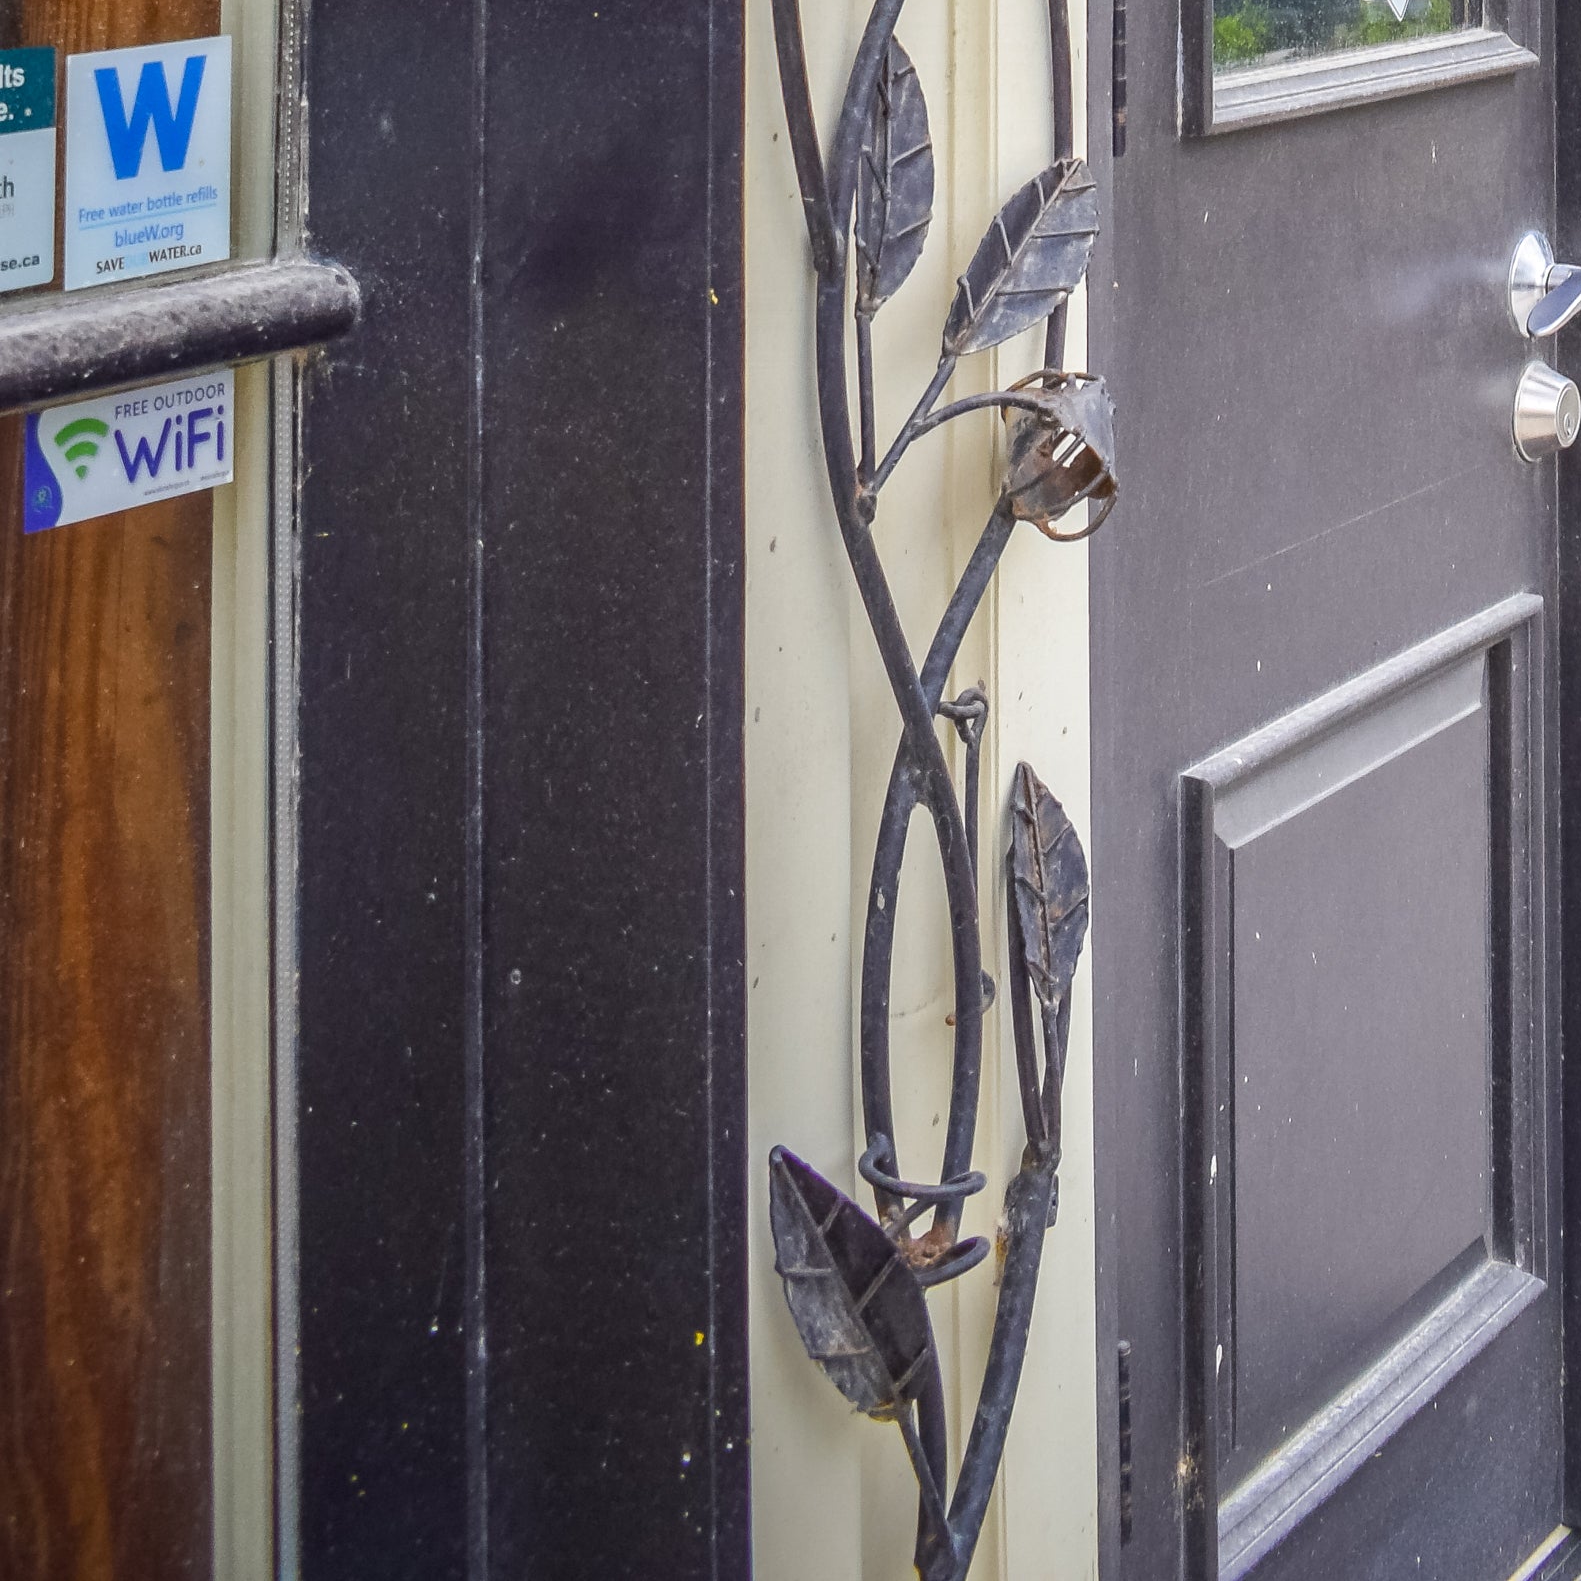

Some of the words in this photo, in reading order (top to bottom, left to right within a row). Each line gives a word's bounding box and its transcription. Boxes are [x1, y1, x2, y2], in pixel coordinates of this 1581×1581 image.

[94, 55, 207, 181] W
[79, 207, 105, 224] Free
[109, 202, 142, 217] water
[147, 192, 182, 211] bottle
[186, 186, 218, 204] refills
[114, 222, 184, 248] blueW.org
[115, 399, 149, 420] FREE
[154, 382, 225, 411] OUTDOOR
[114, 404, 225, 483] WiFi
